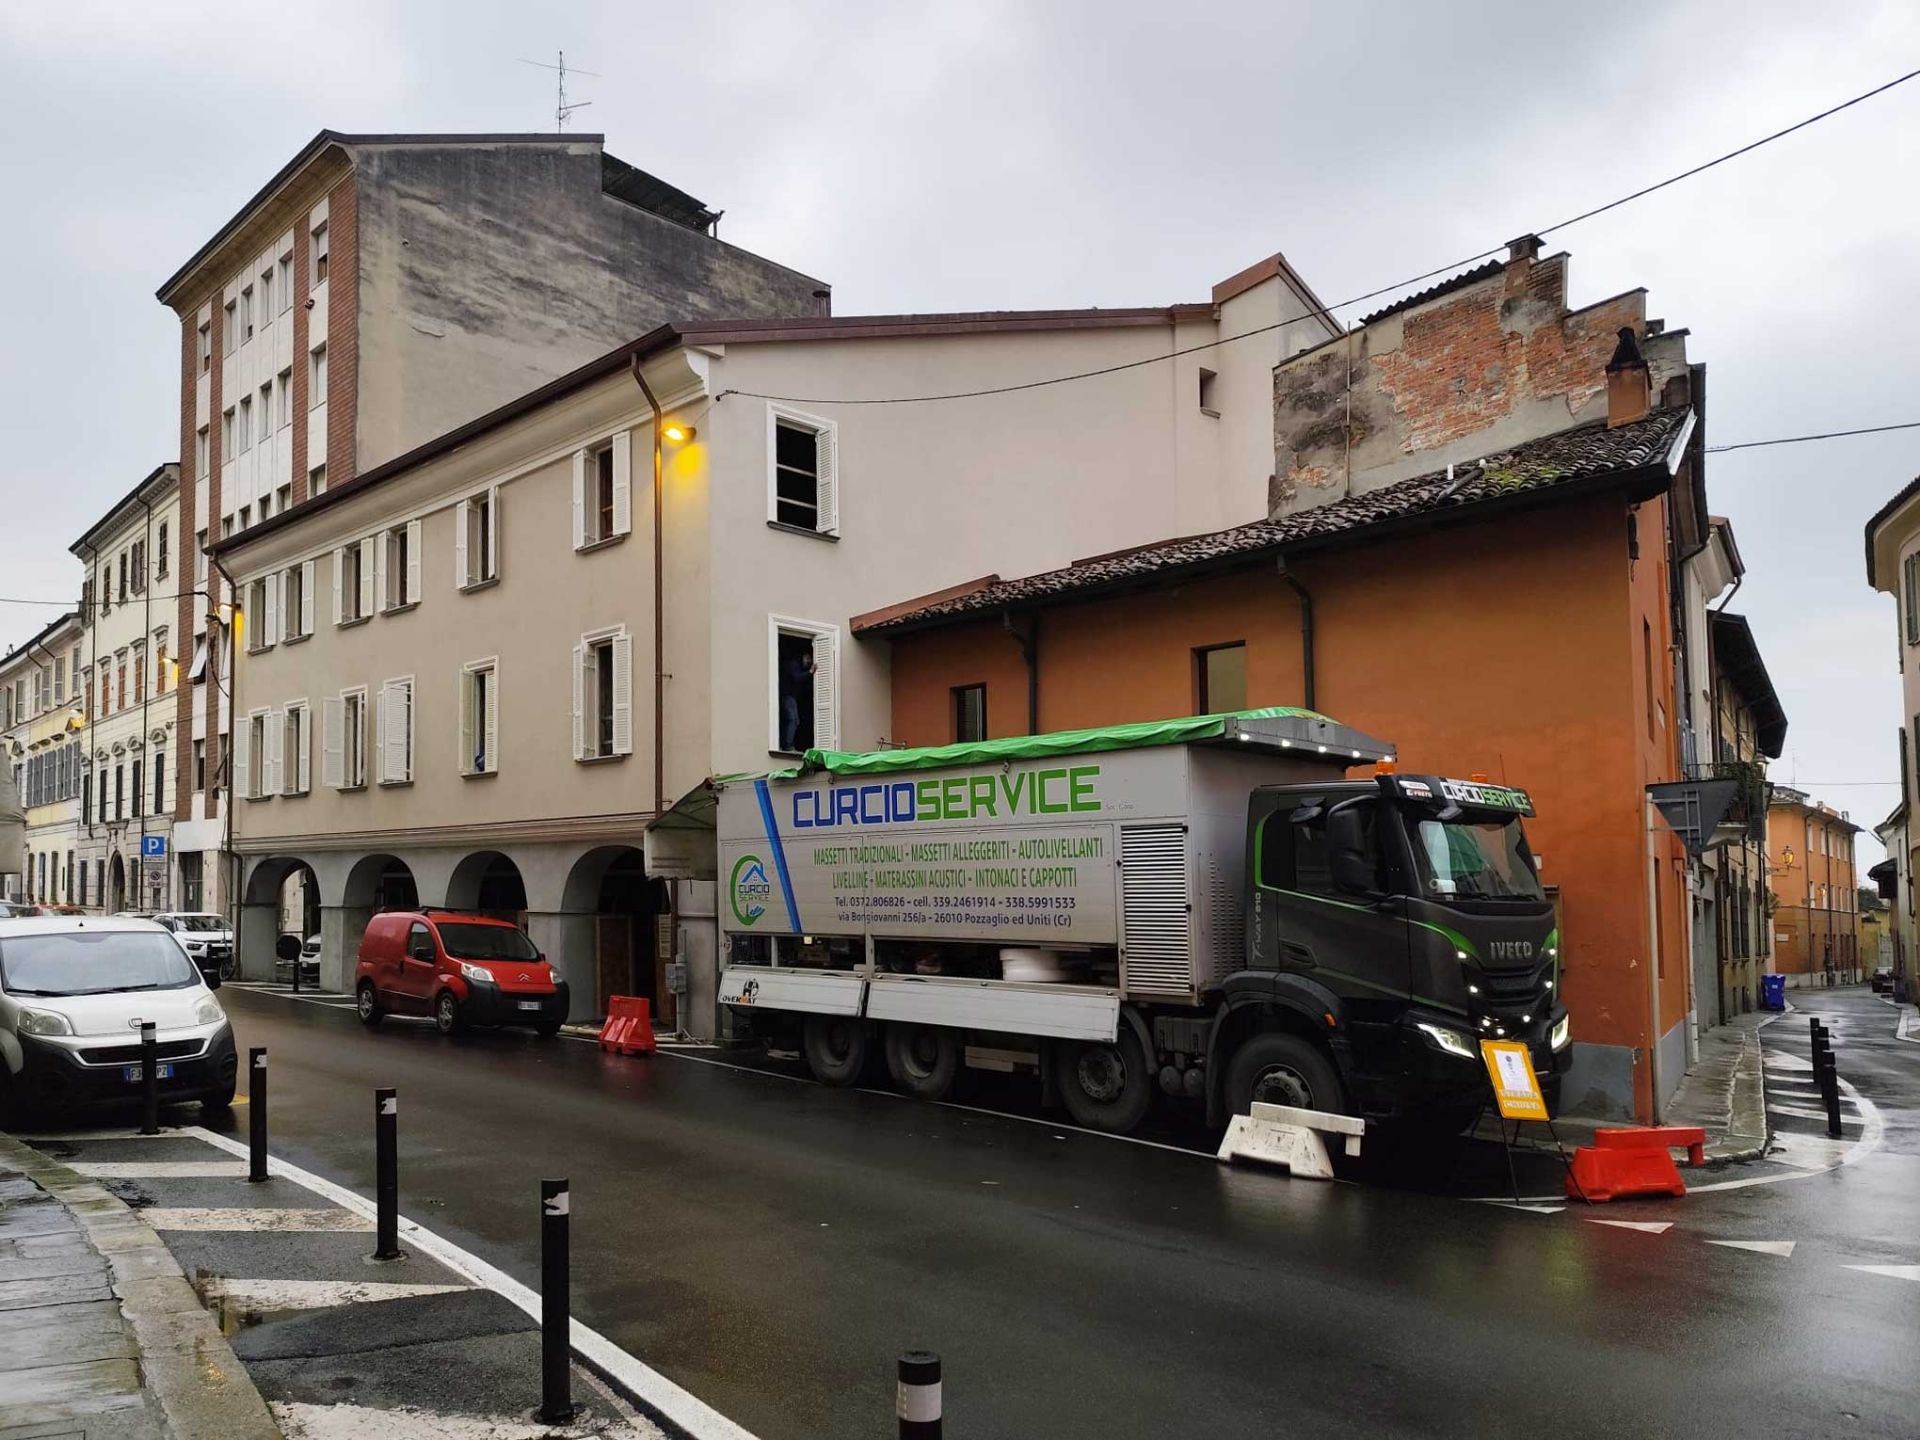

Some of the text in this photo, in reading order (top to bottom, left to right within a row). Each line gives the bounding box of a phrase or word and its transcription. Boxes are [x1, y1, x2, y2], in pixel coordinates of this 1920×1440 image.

[793, 765, 1102, 827] CURCIOSERVICE
[148, 838, 159, 853] P
[814, 847, 848, 866] MASSETTI
[850, 845, 904, 865] TRADIZIONALI
[911, 842, 951, 863] MASSETTI
[953, 840, 1010, 862] ALLEGGERITI
[1018, 837, 1103, 860] AUTOLIVELLANTI
[832, 871, 869, 889] LIVELLINE
[875, 869, 927, 889] MATERASSINI
[928, 868, 966, 889] ACUSTICI
[975, 868, 1019, 888] INTONACI
[1021, 868, 1027, 887] E
[1029, 866, 1077, 888] CAPPOTTI
[738, 884, 770, 894] CURCIO
[834, 896, 848, 907] Tel.
[850, 896, 906, 908] 0372.806826
[913, 896, 931, 907] cell.
[933, 896, 996, 909] 339.2461914
[1005, 897, 1076, 909] 338.5991533
[838, 911, 850, 922] via
[851, 911, 901, 925] Bongiovanni
[934, 912, 963, 924] 26010
[965, 913, 1010, 927] Pozzaglio
[1012, 914, 1024, 925] ed
[1027, 914, 1051, 925] Uniti
[1054, 913, 1072, 927] (Cr)
[1490, 941, 1533, 960] IVECO
